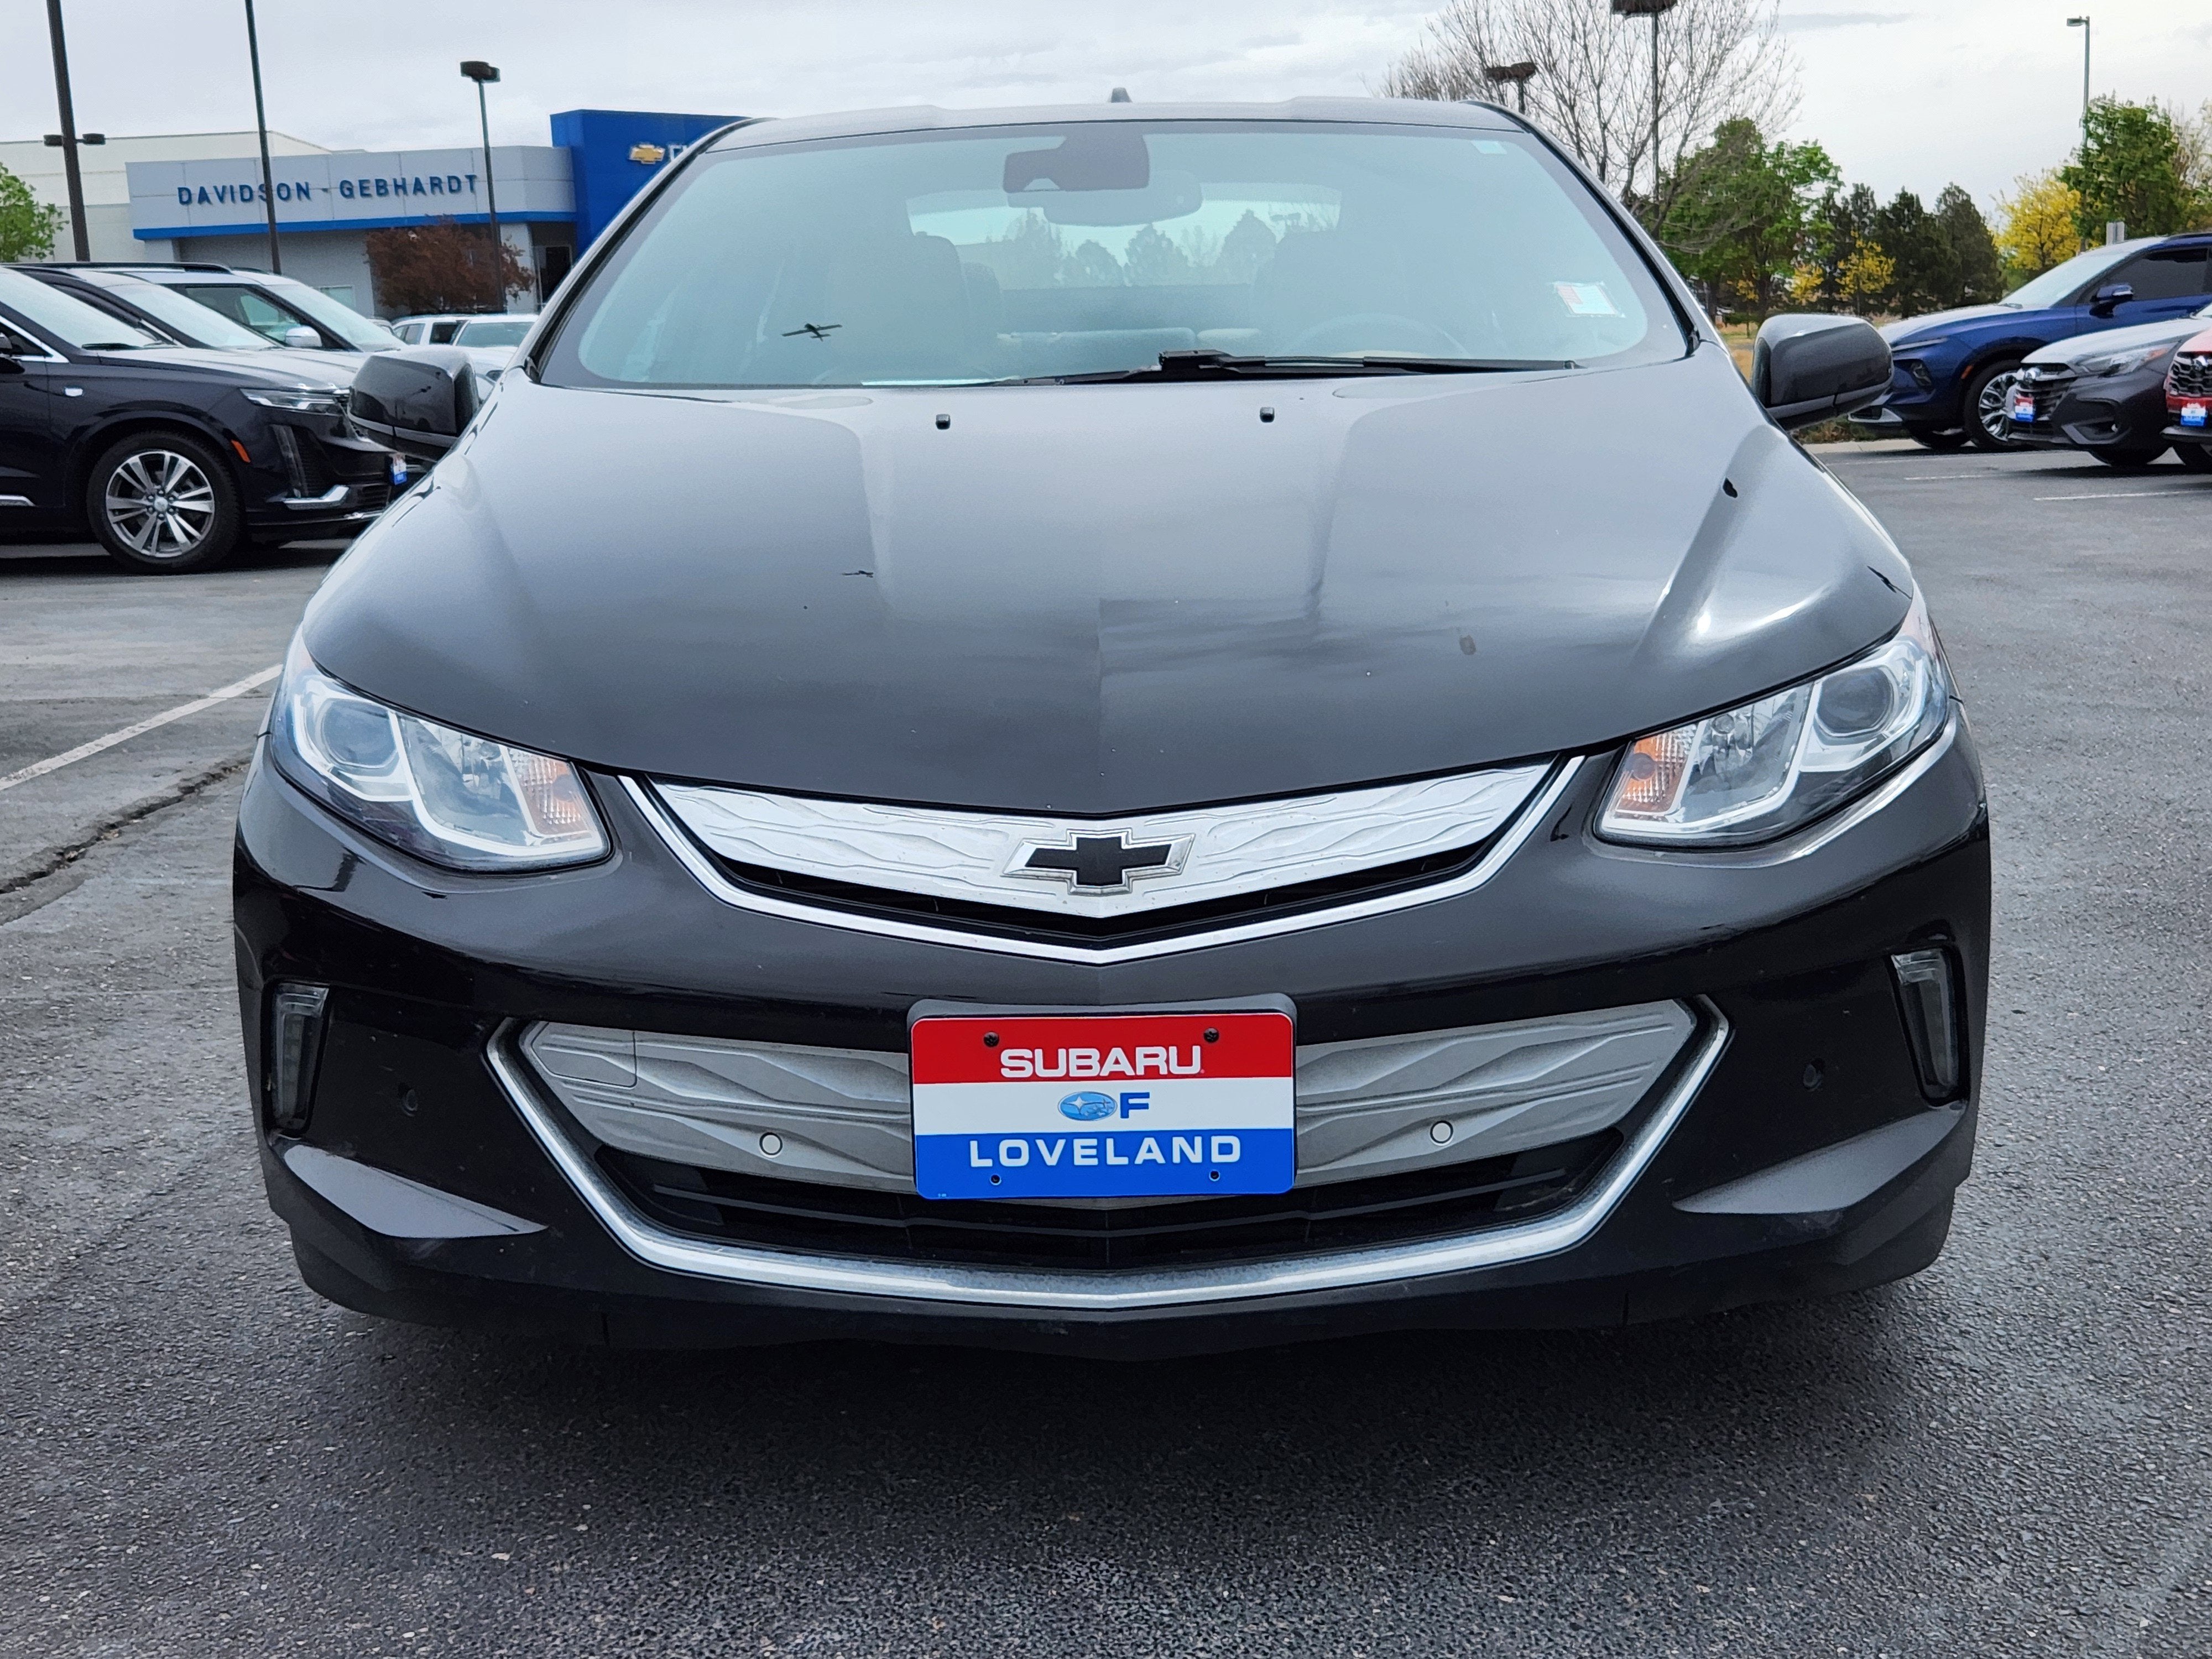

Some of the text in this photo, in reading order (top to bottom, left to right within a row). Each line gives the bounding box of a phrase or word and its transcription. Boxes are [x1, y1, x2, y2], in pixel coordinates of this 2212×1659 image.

[177, 182, 311, 205] DAVIDSON
[339, 174, 477, 199] GEBHARDT
[1000, 1045, 1202, 1078] SUBARU
[969, 1135, 1241, 1168] LOVELAND
